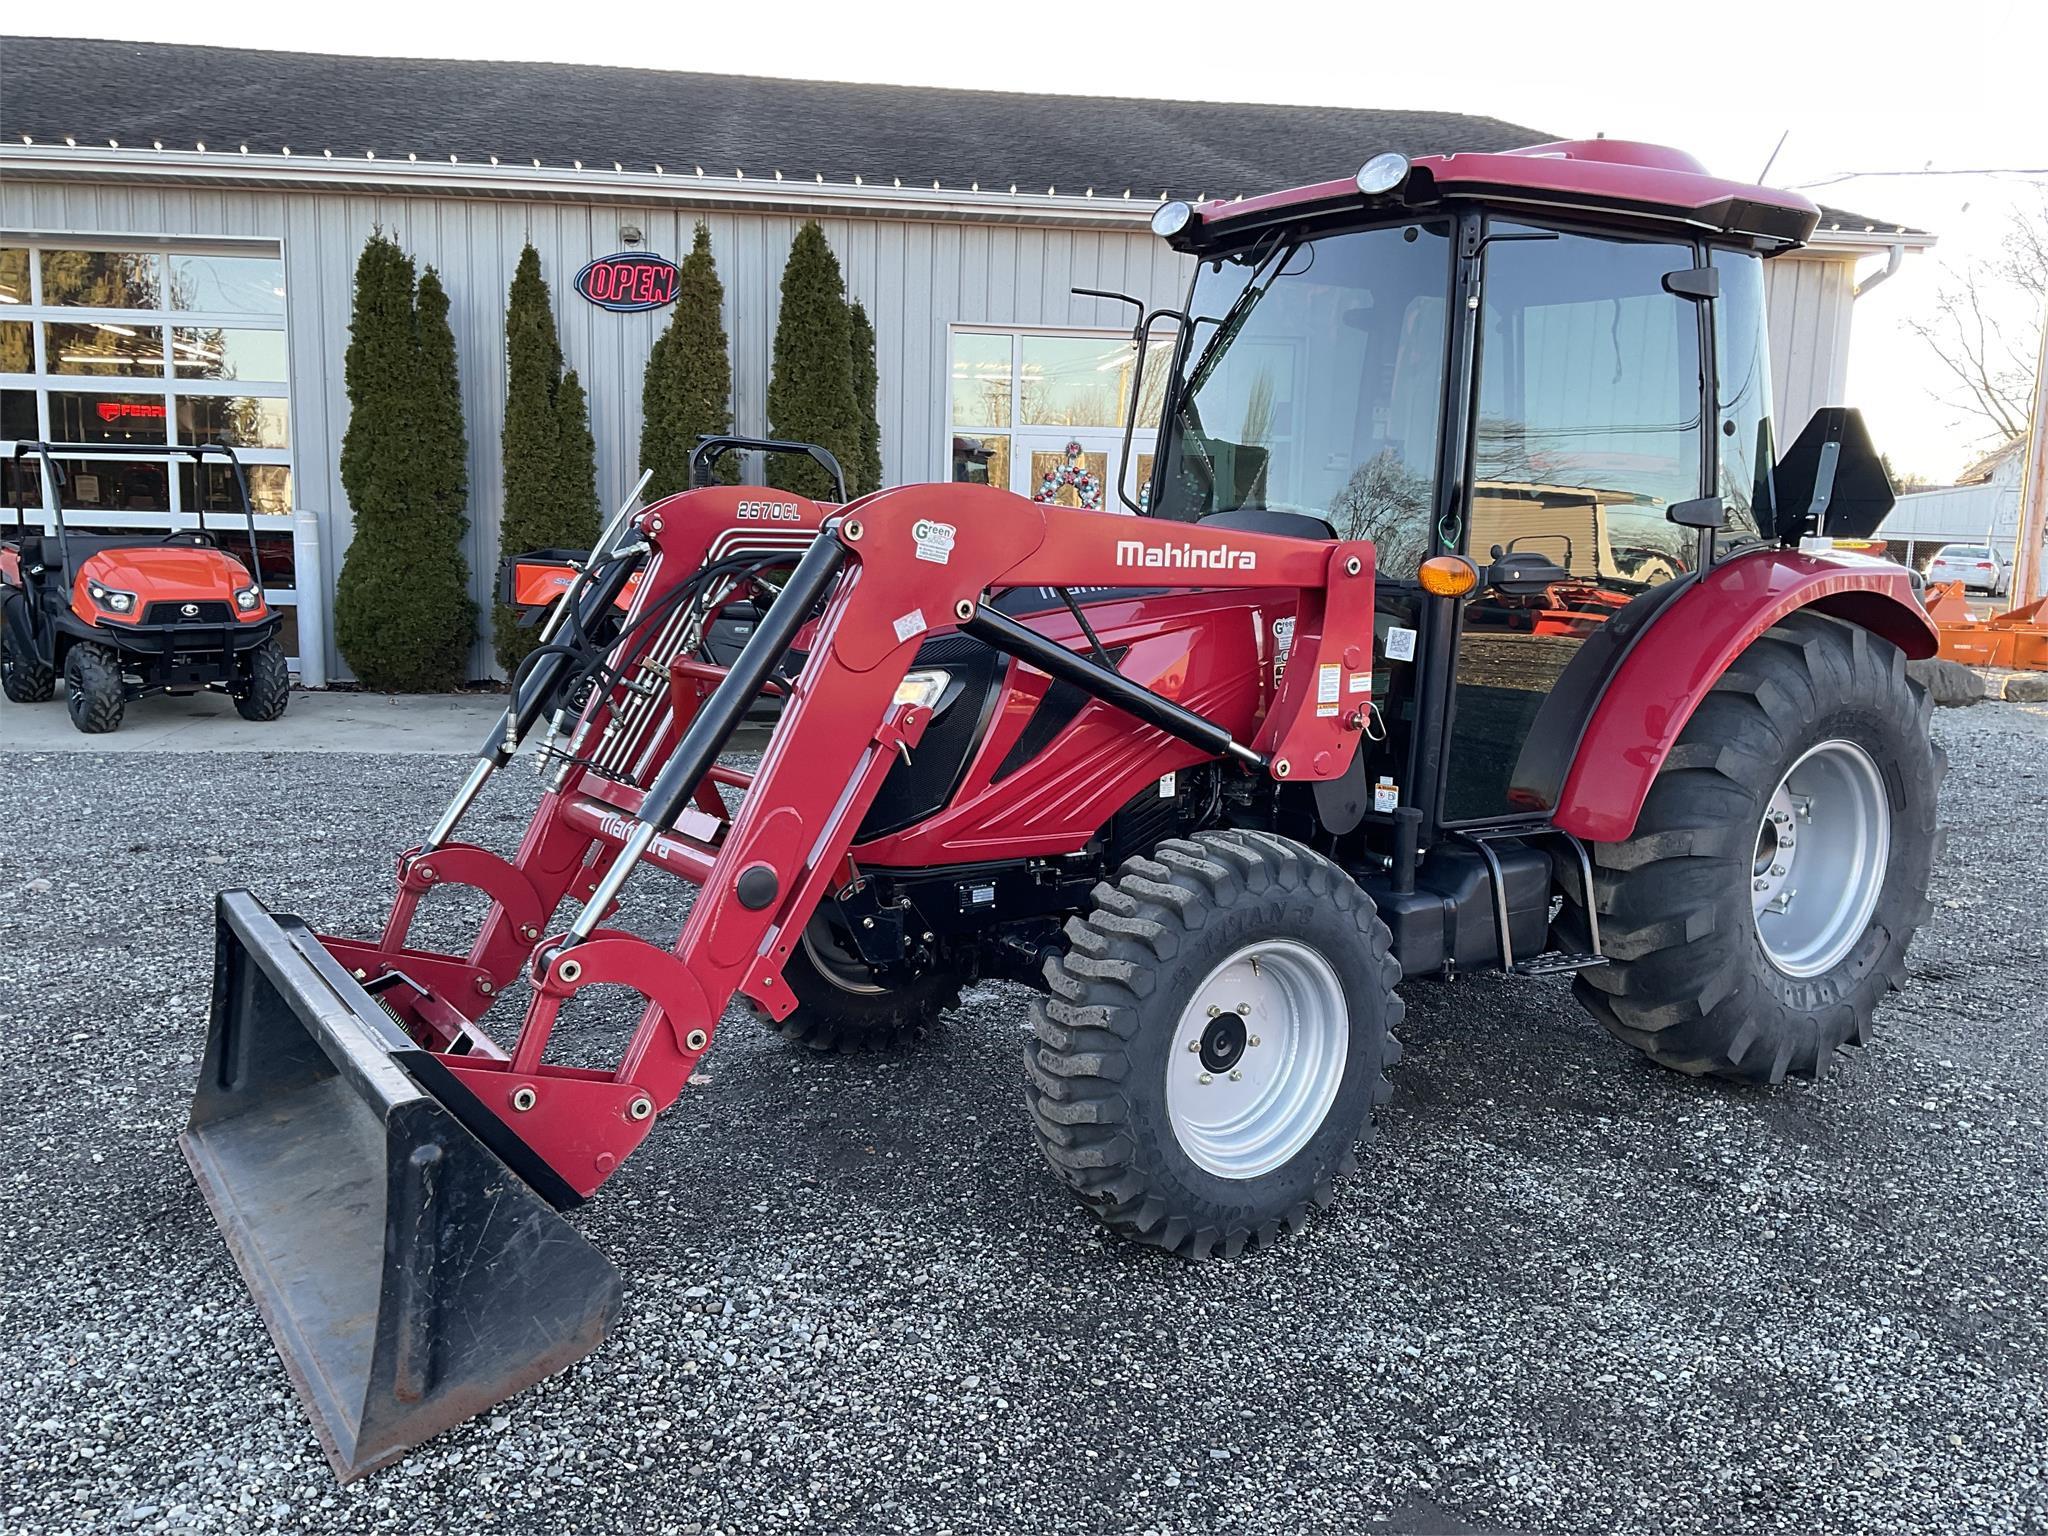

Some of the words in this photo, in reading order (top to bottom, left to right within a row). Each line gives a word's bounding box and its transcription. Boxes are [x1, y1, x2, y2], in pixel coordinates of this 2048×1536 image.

[589, 264, 674, 302] OPEN
[737, 501, 801, 521] 2670CL
[915, 523, 951, 539] Green
[1116, 540, 1256, 570] Mahindra
